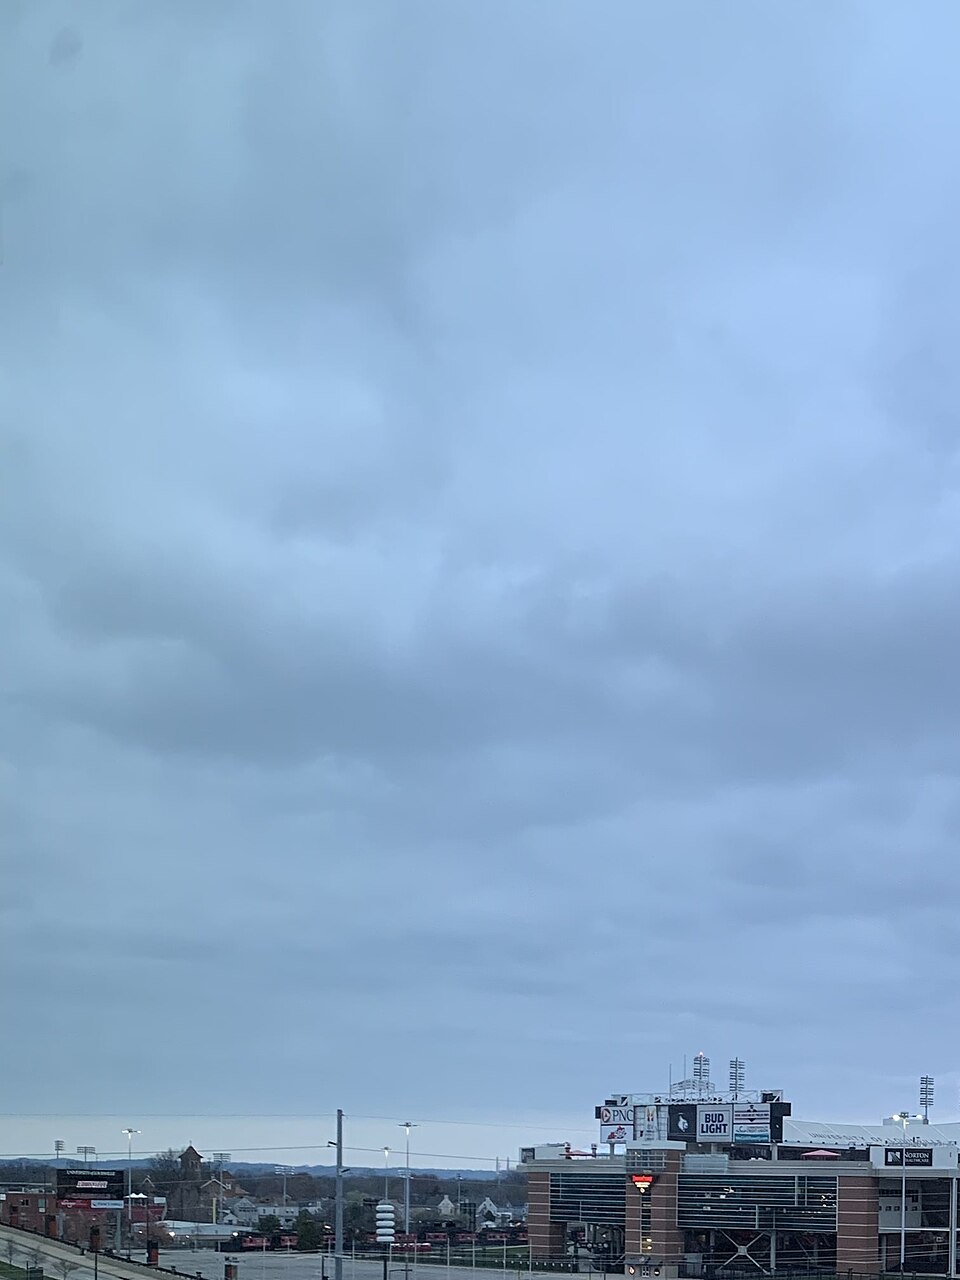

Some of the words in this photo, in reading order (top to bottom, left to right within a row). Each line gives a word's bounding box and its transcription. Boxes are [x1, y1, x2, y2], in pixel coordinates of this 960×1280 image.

[612, 1109, 634, 1122] PNC
[704, 1113, 724, 1123] BUD
[701, 1123, 728, 1134] LIGHT
[904, 1151, 930, 1159] NORTON
